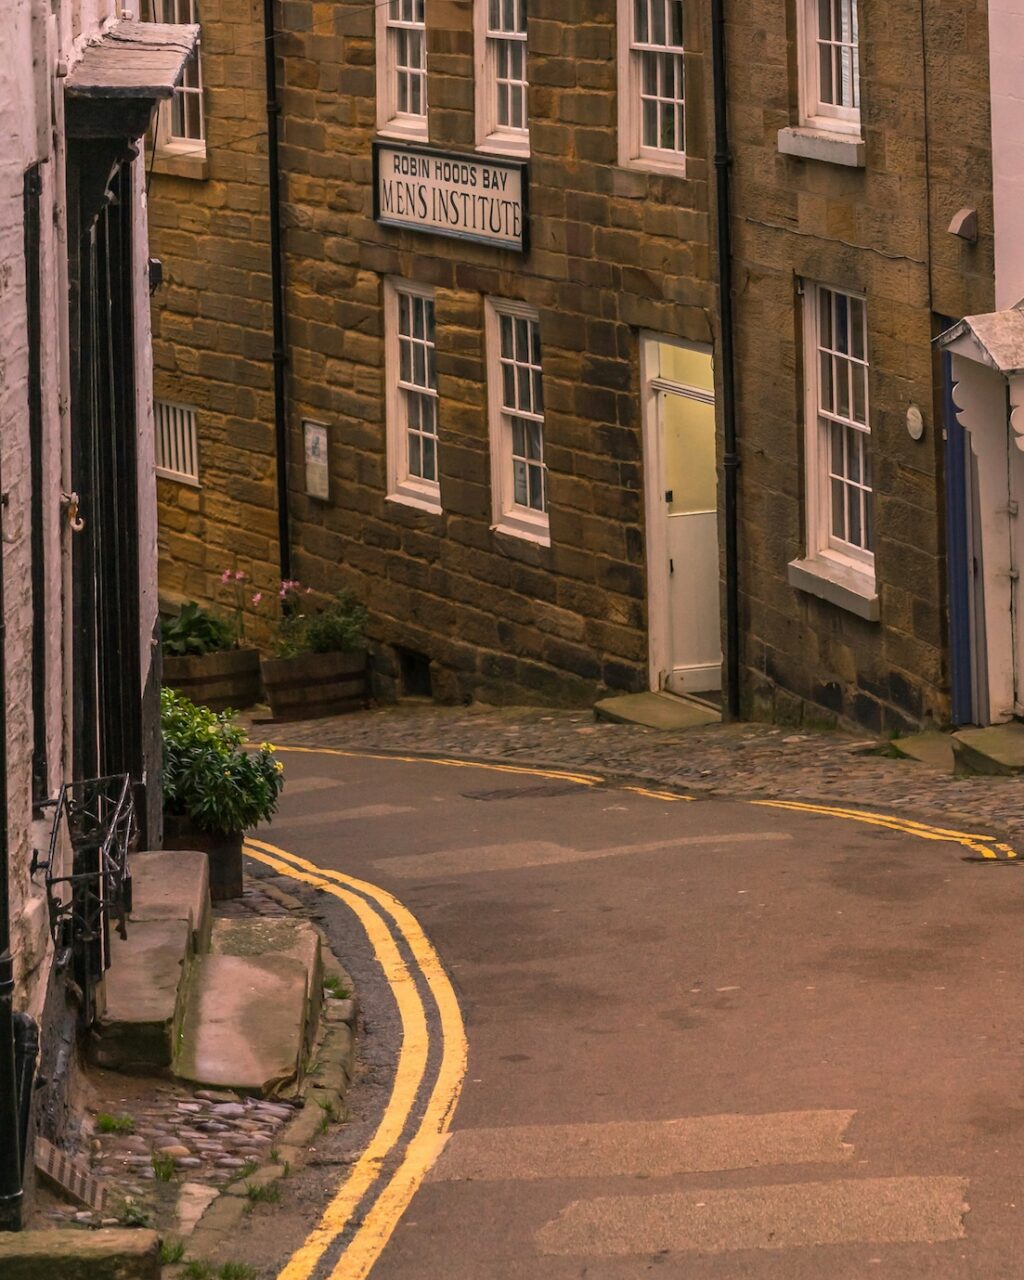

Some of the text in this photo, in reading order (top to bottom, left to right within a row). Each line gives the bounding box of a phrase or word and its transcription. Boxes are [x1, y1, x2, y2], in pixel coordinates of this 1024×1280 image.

[393, 154, 508, 192] ROBIN HOOD'S BAY
[381, 178, 521, 238] MEN'S INSTITUTE
